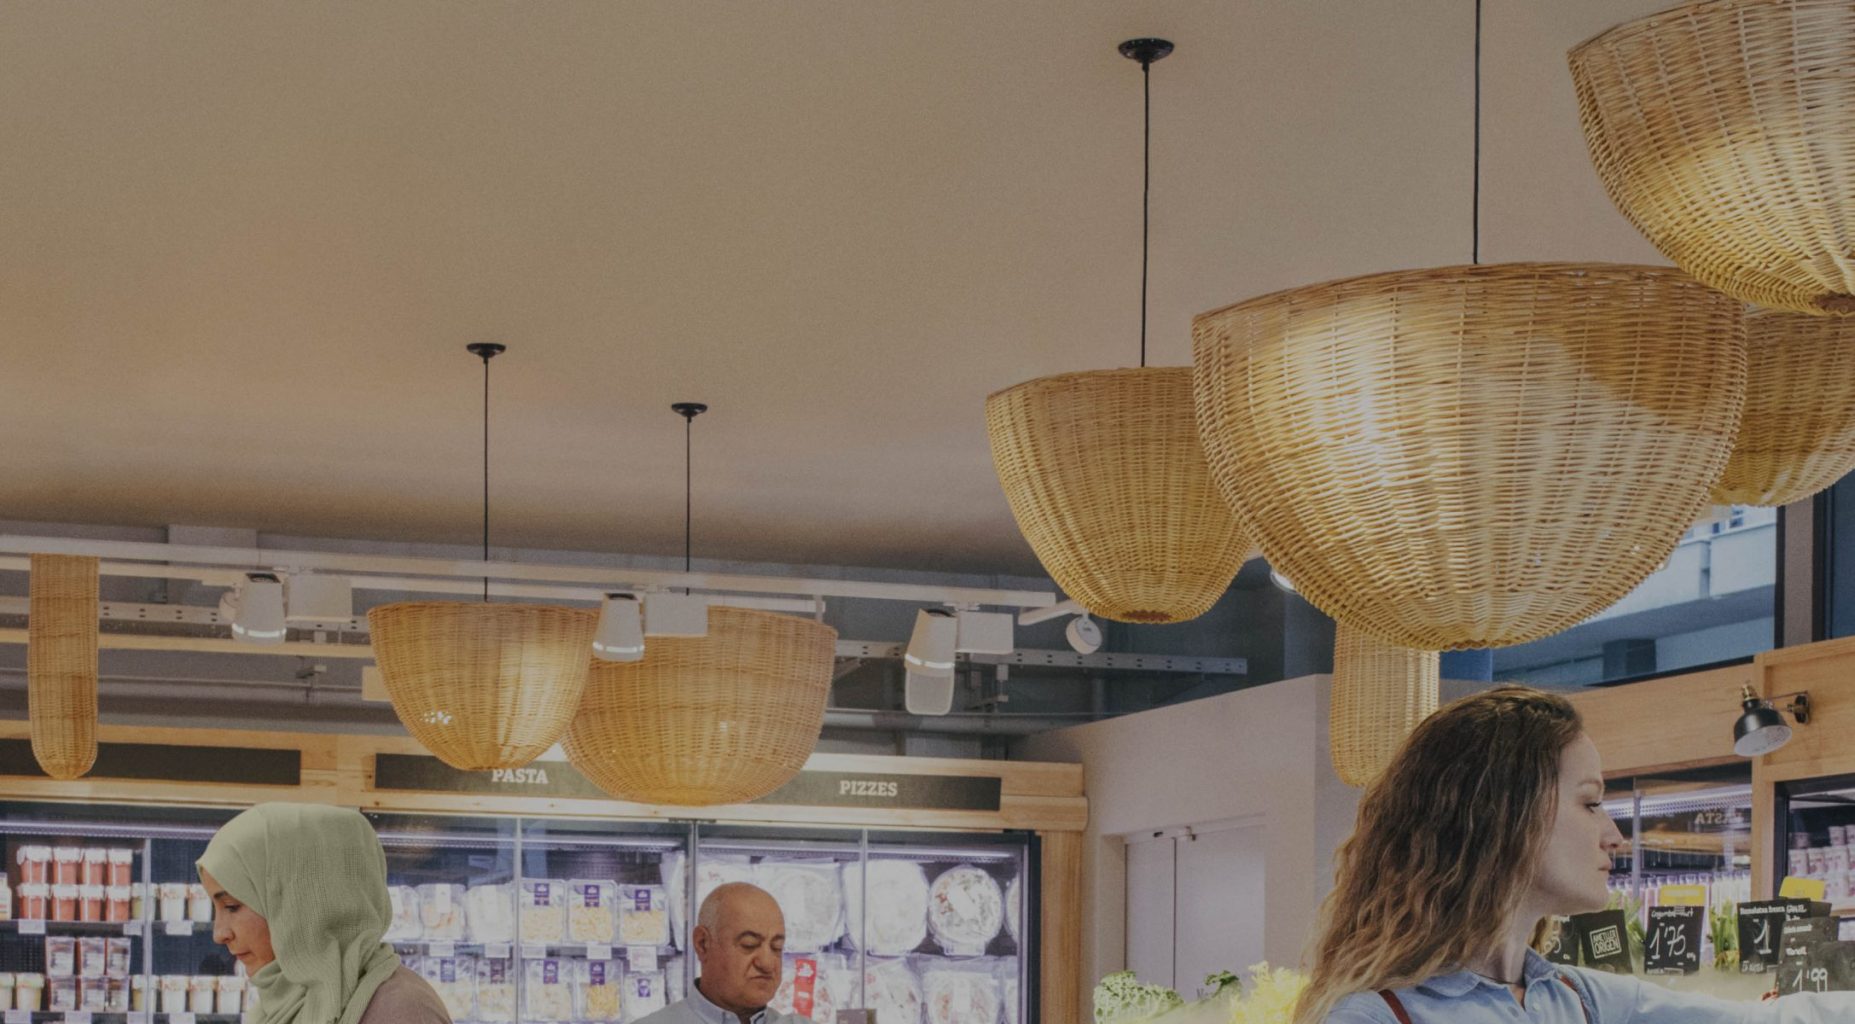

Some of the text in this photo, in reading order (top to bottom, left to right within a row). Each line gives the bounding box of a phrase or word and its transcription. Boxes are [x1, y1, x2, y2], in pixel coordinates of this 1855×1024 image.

[491, 768, 549, 784] PASTA
[839, 780, 898, 797] PIZZES
[1594, 938, 1620, 955] ORIGEN
[1649, 923, 1686, 960] 1'75
